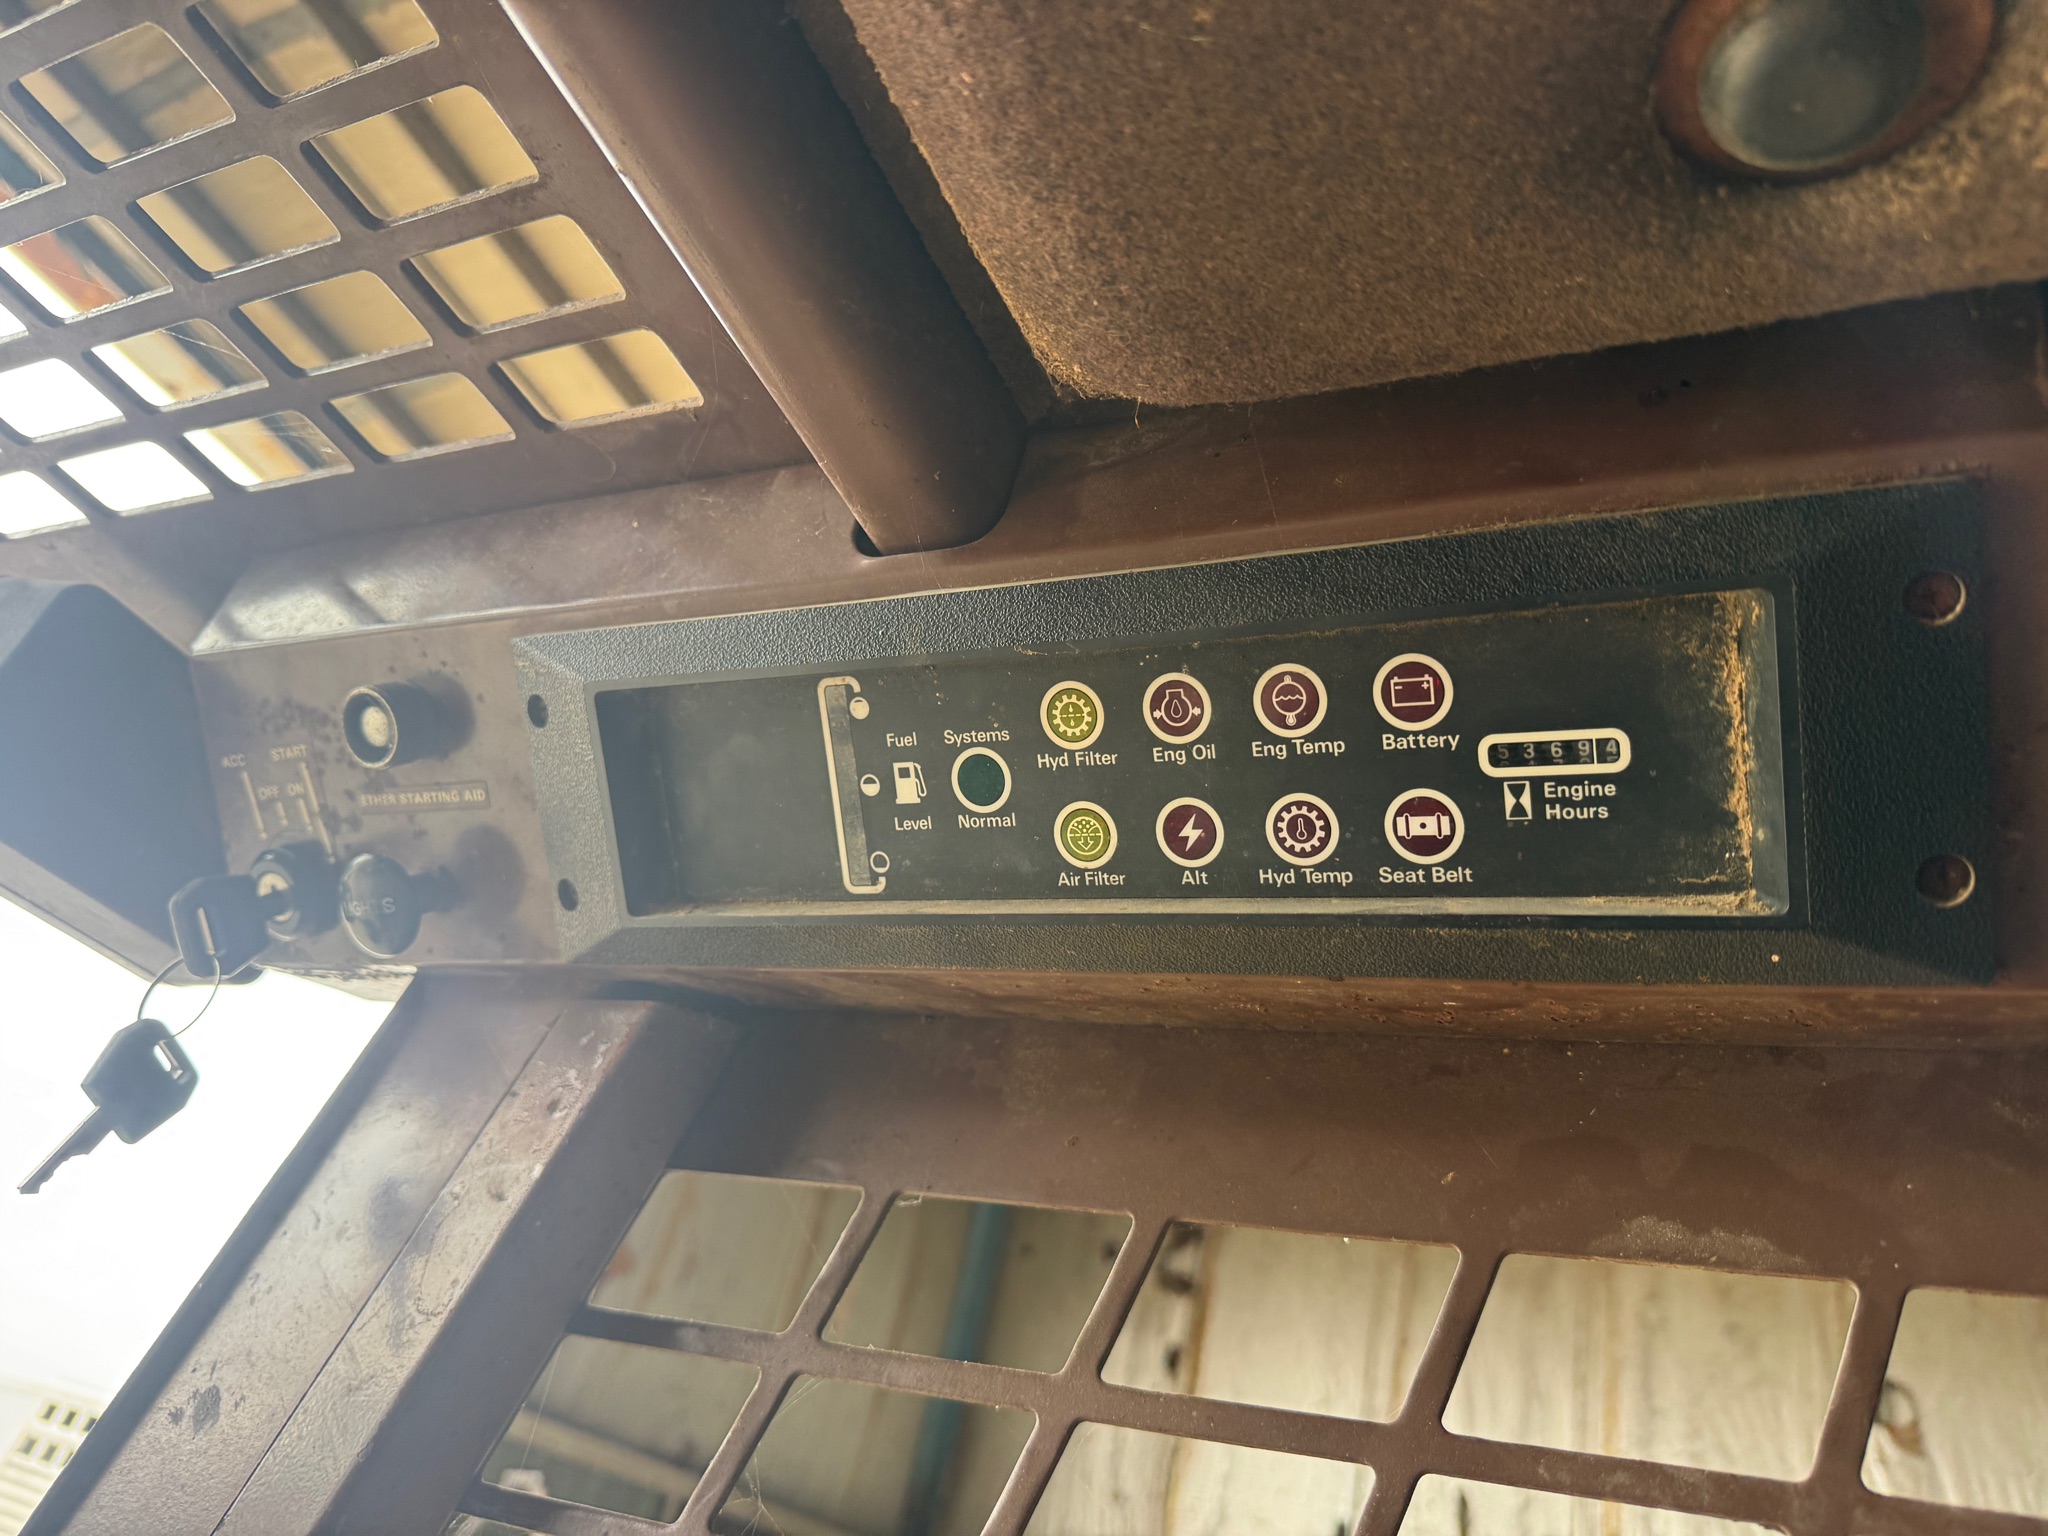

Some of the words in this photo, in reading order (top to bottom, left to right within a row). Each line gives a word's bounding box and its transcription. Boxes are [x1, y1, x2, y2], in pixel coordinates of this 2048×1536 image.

[886, 732, 918, 748] Fuel
[943, 729, 1010, 746] Systems
[1381, 733, 1460, 752] Battery
[270, 744, 308, 762] START
[1153, 747, 1187, 765] Eng
[1192, 744, 1216, 761] Oil
[1251, 740, 1287, 760] Eng
[1291, 738, 1346, 757] Temp
[222, 753, 246, 768] ACC
[1037, 752, 1069, 771] Hyd
[1075, 751, 1118, 767] Filter
[258, 784, 280, 800] OFF
[287, 782, 305, 798] ON
[361, 792, 397, 808] ETHER
[399, 789, 459, 805] STARTING
[463, 788, 486, 802] AID
[1544, 780, 1616, 801] Engine
[958, 813, 1016, 829] Normal
[1545, 804, 1609, 820] Hours
[894, 816, 932, 831] Level
[1058, 872, 1080, 888] Air
[1085, 871, 1126, 886] Filter
[1182, 871, 1208, 886] Alt
[1259, 869, 1296, 887] Hyd
[1301, 869, 1353, 886] Temp
[1379, 866, 1426, 884] Seat
[1432, 866, 1473, 883] Belt
